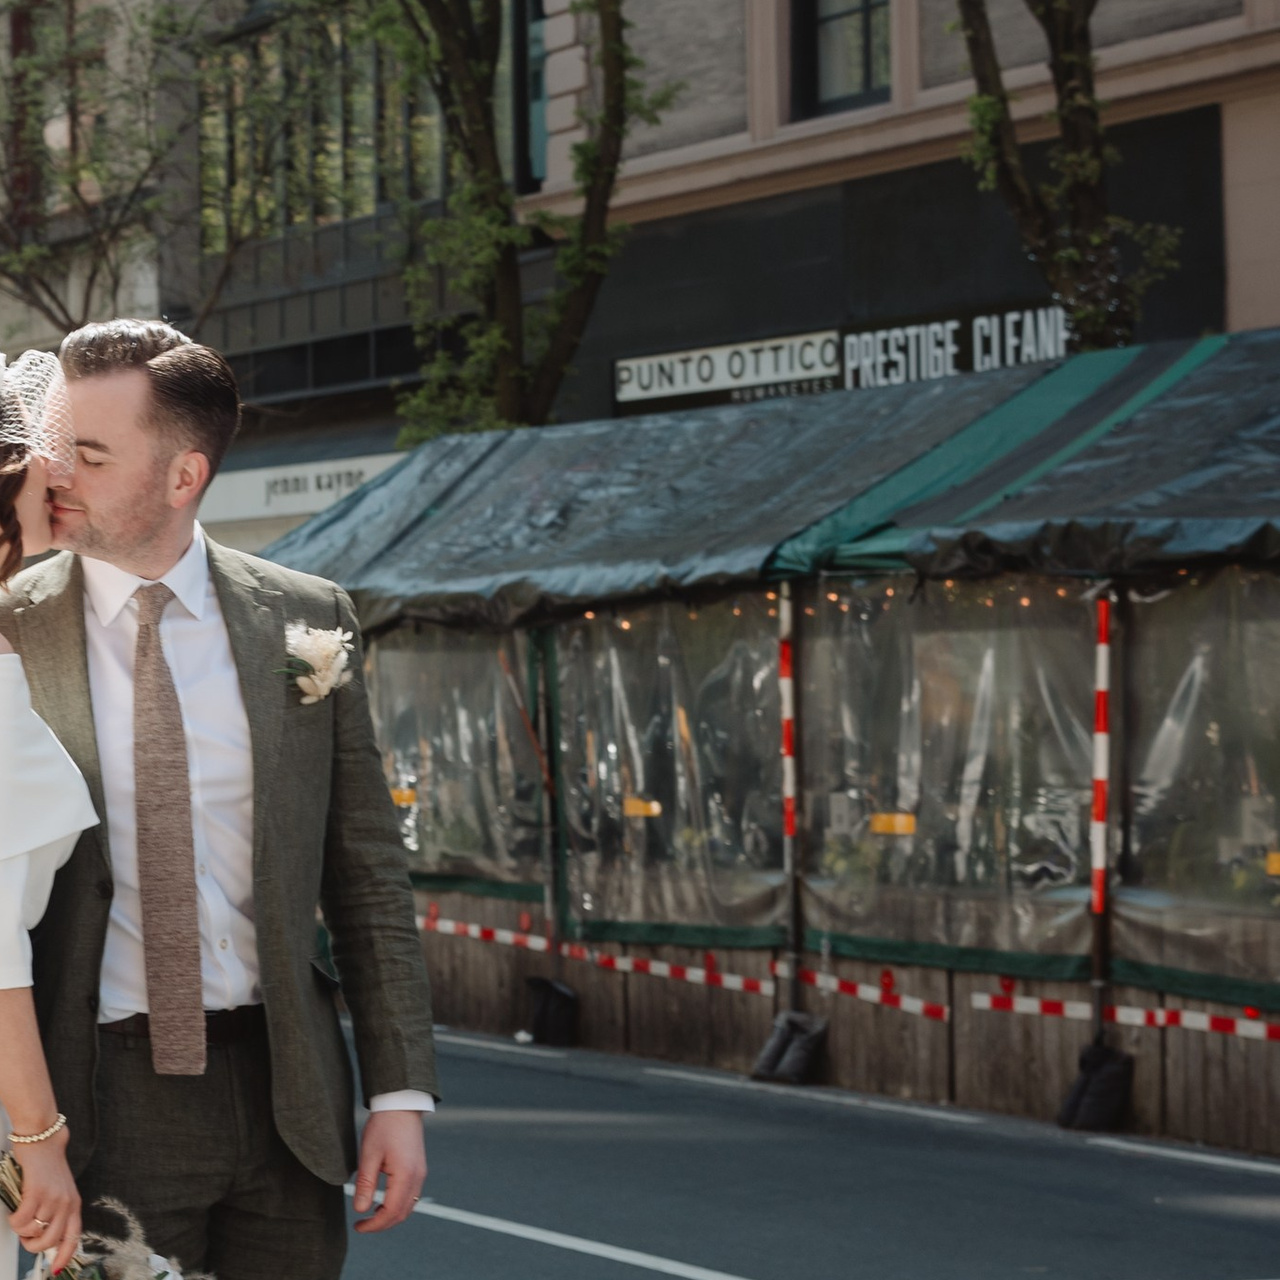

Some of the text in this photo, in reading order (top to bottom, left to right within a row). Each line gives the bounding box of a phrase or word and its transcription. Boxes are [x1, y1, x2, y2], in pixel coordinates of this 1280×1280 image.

[617, 338, 838, 393] PUNTO OTTICO
[844, 320, 960, 391] PRESTIGE
